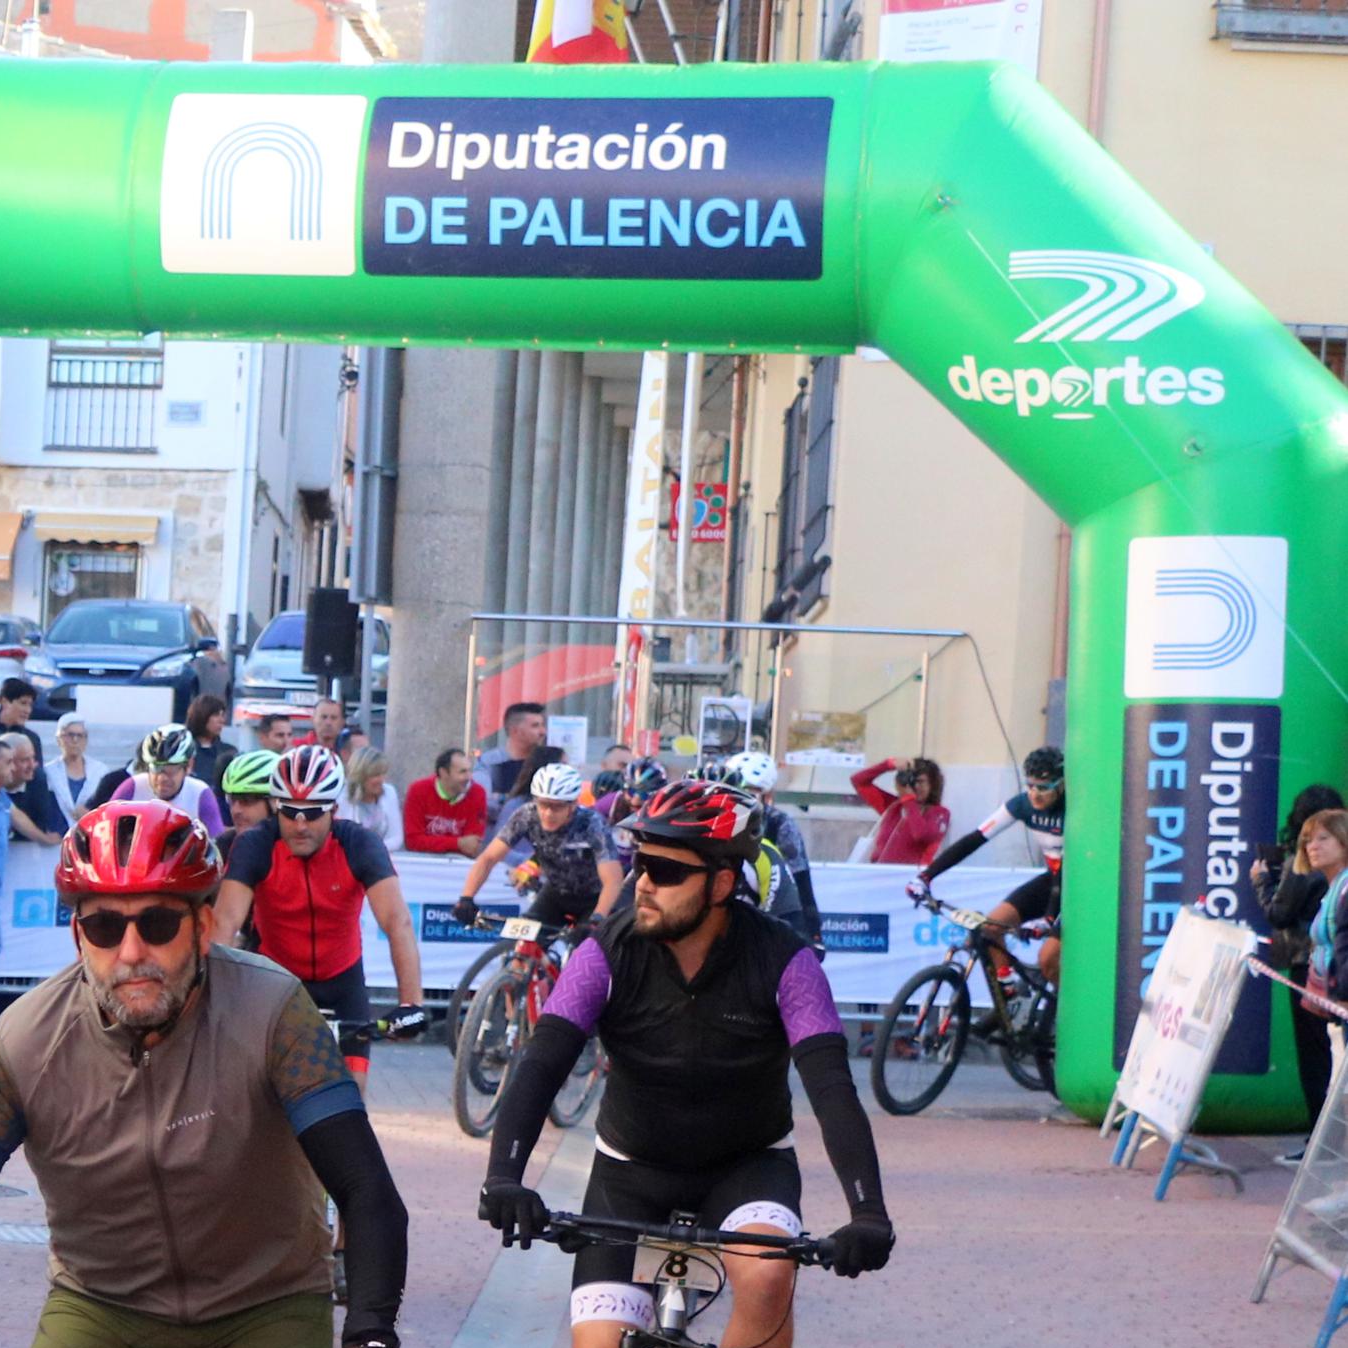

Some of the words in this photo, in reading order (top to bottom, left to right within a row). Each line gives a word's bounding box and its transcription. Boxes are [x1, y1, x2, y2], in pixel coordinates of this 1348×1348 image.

[387, 121, 728, 180] Diputación
[384, 197, 468, 245] DE
[488, 197, 806, 247] PALENCIA
[948, 355, 1226, 417] deportes
[1147, 721, 1188, 790] DE
[1200, 721, 1255, 918] Diputac
[1140, 806, 1186, 1000] PALEN
[665, 1251, 688, 1278] 8
